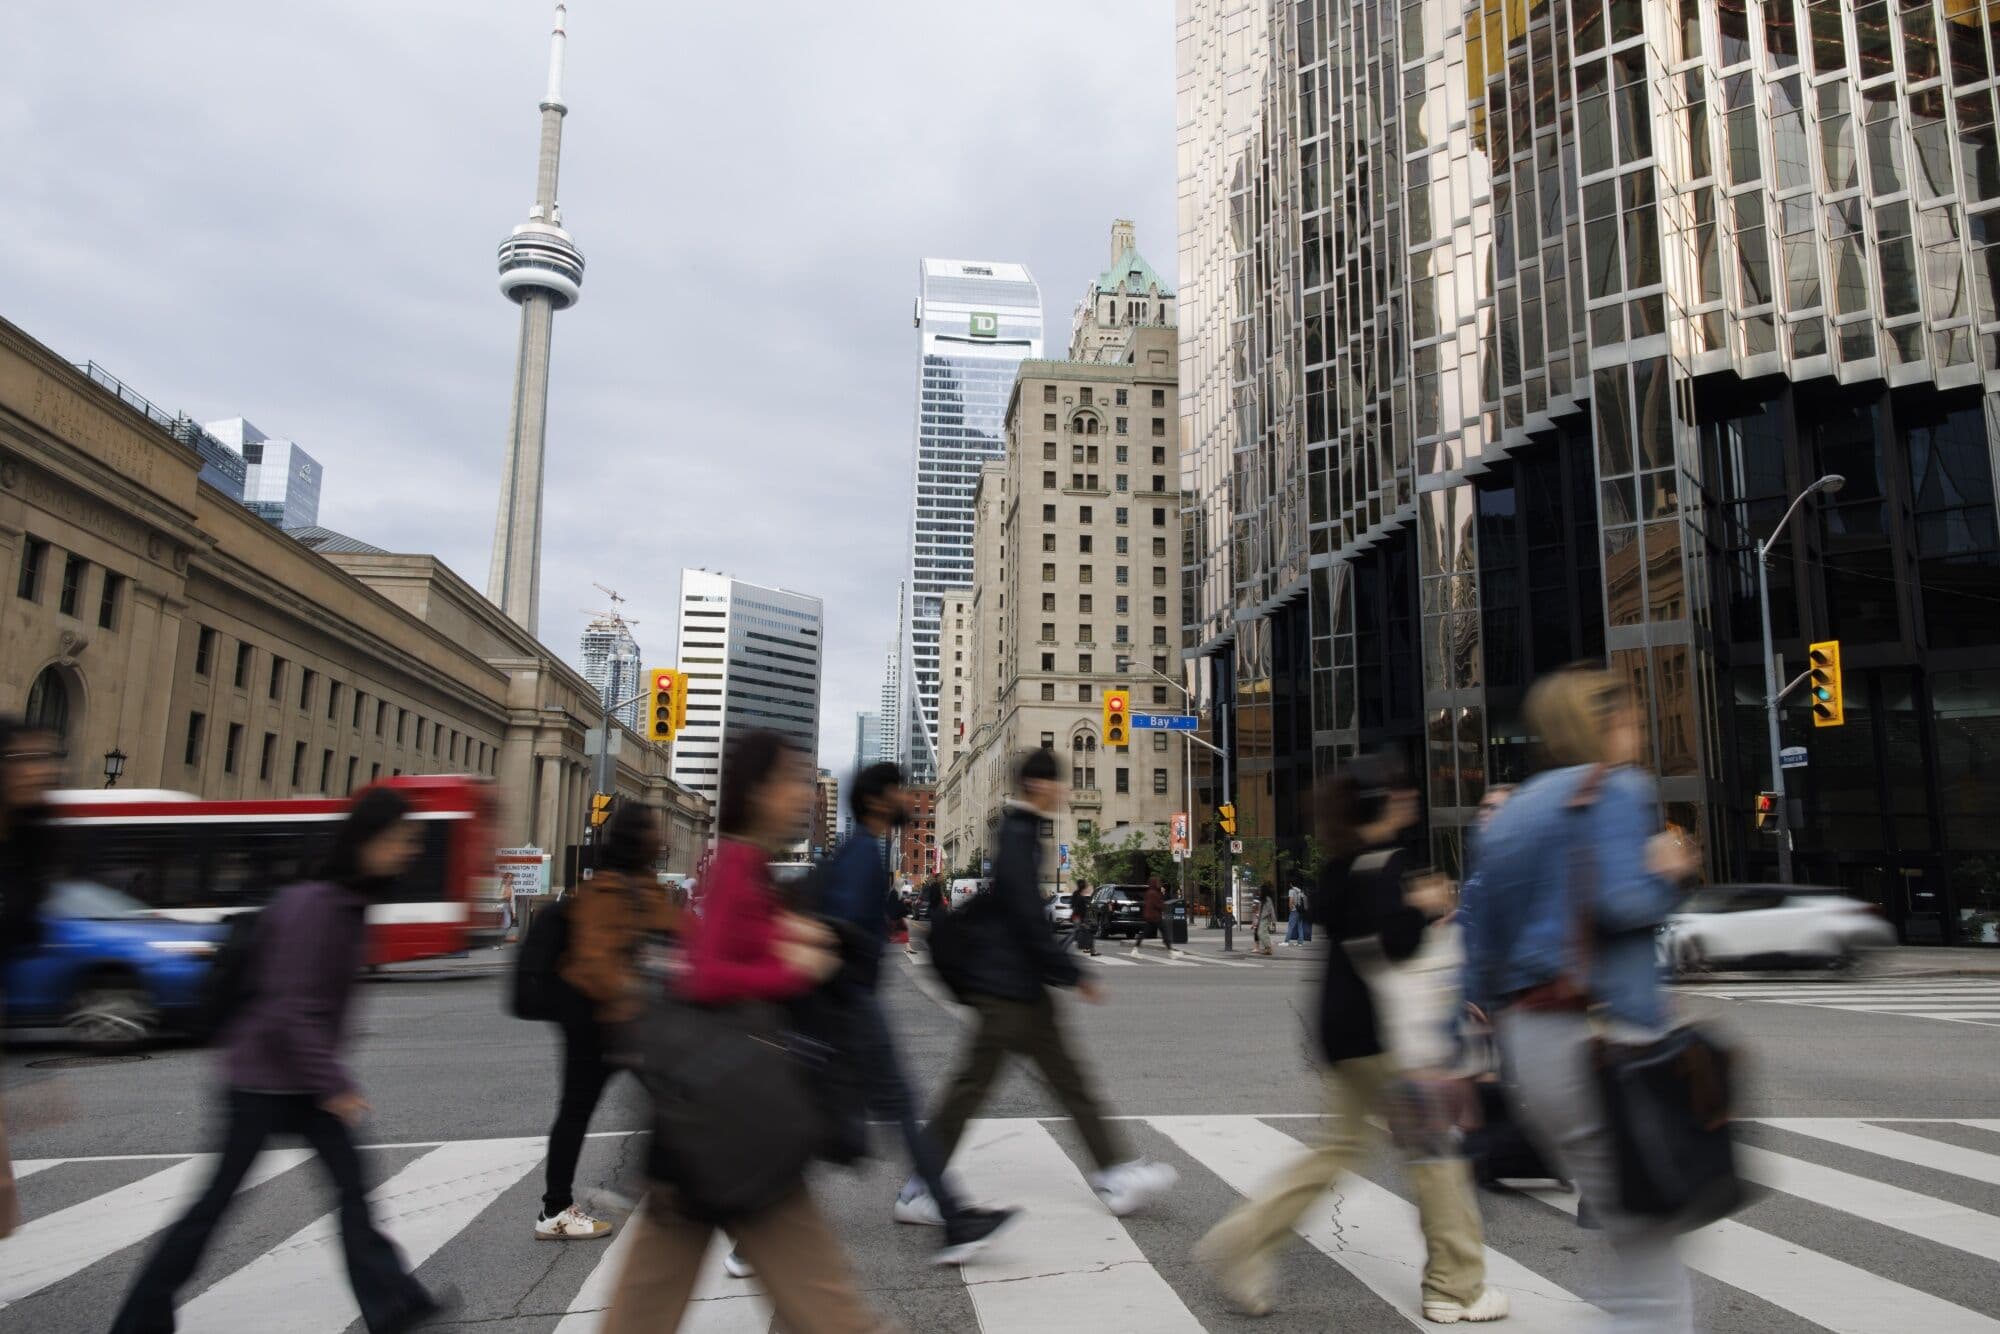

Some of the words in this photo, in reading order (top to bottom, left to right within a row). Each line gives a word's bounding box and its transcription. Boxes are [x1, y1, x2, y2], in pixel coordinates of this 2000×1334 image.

[973, 316, 994, 330] TD
[1150, 717, 1170, 728] Bay
[953, 886, 973, 894] FedEx
